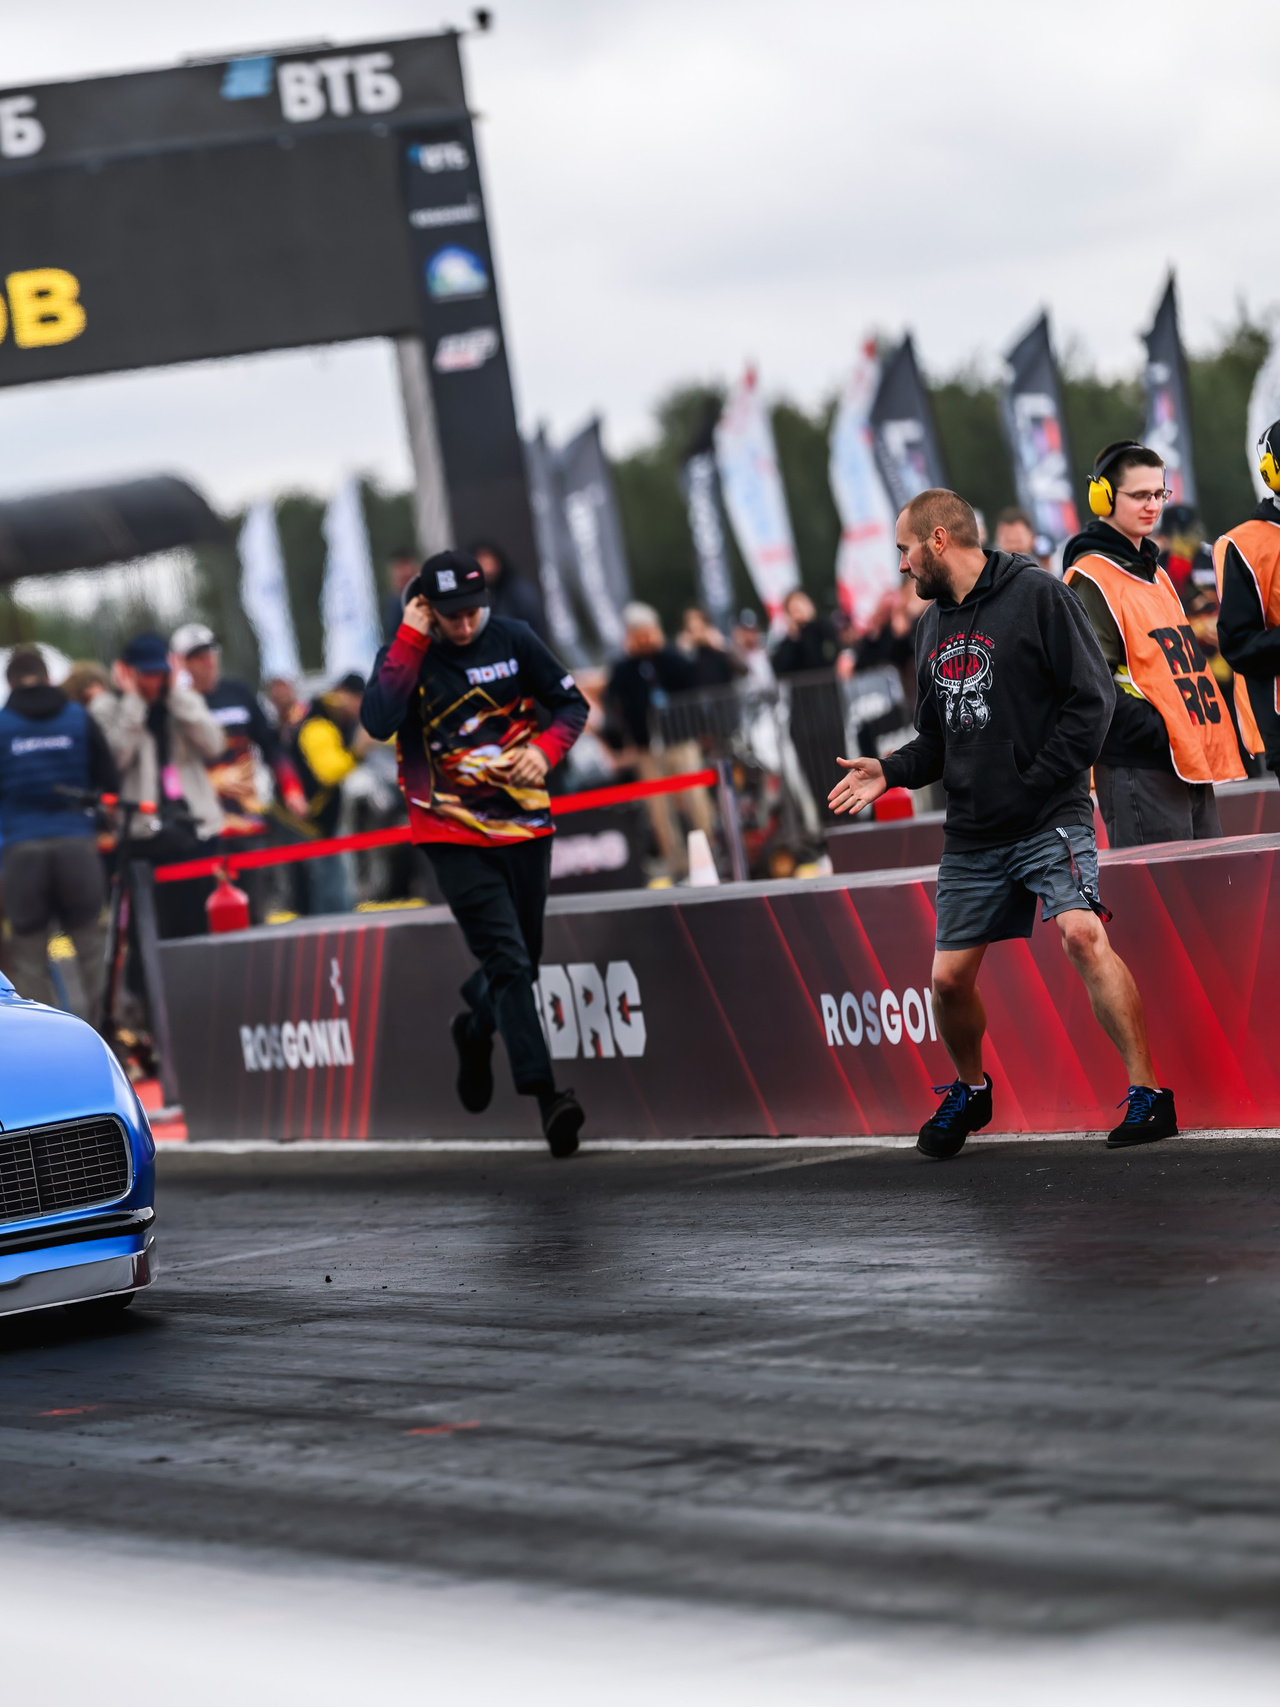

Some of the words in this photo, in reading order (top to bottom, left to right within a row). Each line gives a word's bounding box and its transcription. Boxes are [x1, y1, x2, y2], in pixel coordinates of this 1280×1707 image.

[277, 52, 402, 124] ВТБ
[942, 654, 980, 680] NHRA
[946, 639, 976, 650] SPOT
[532, 960, 646, 1060] DRC
[239, 1017, 354, 1072] ROSGONKI
